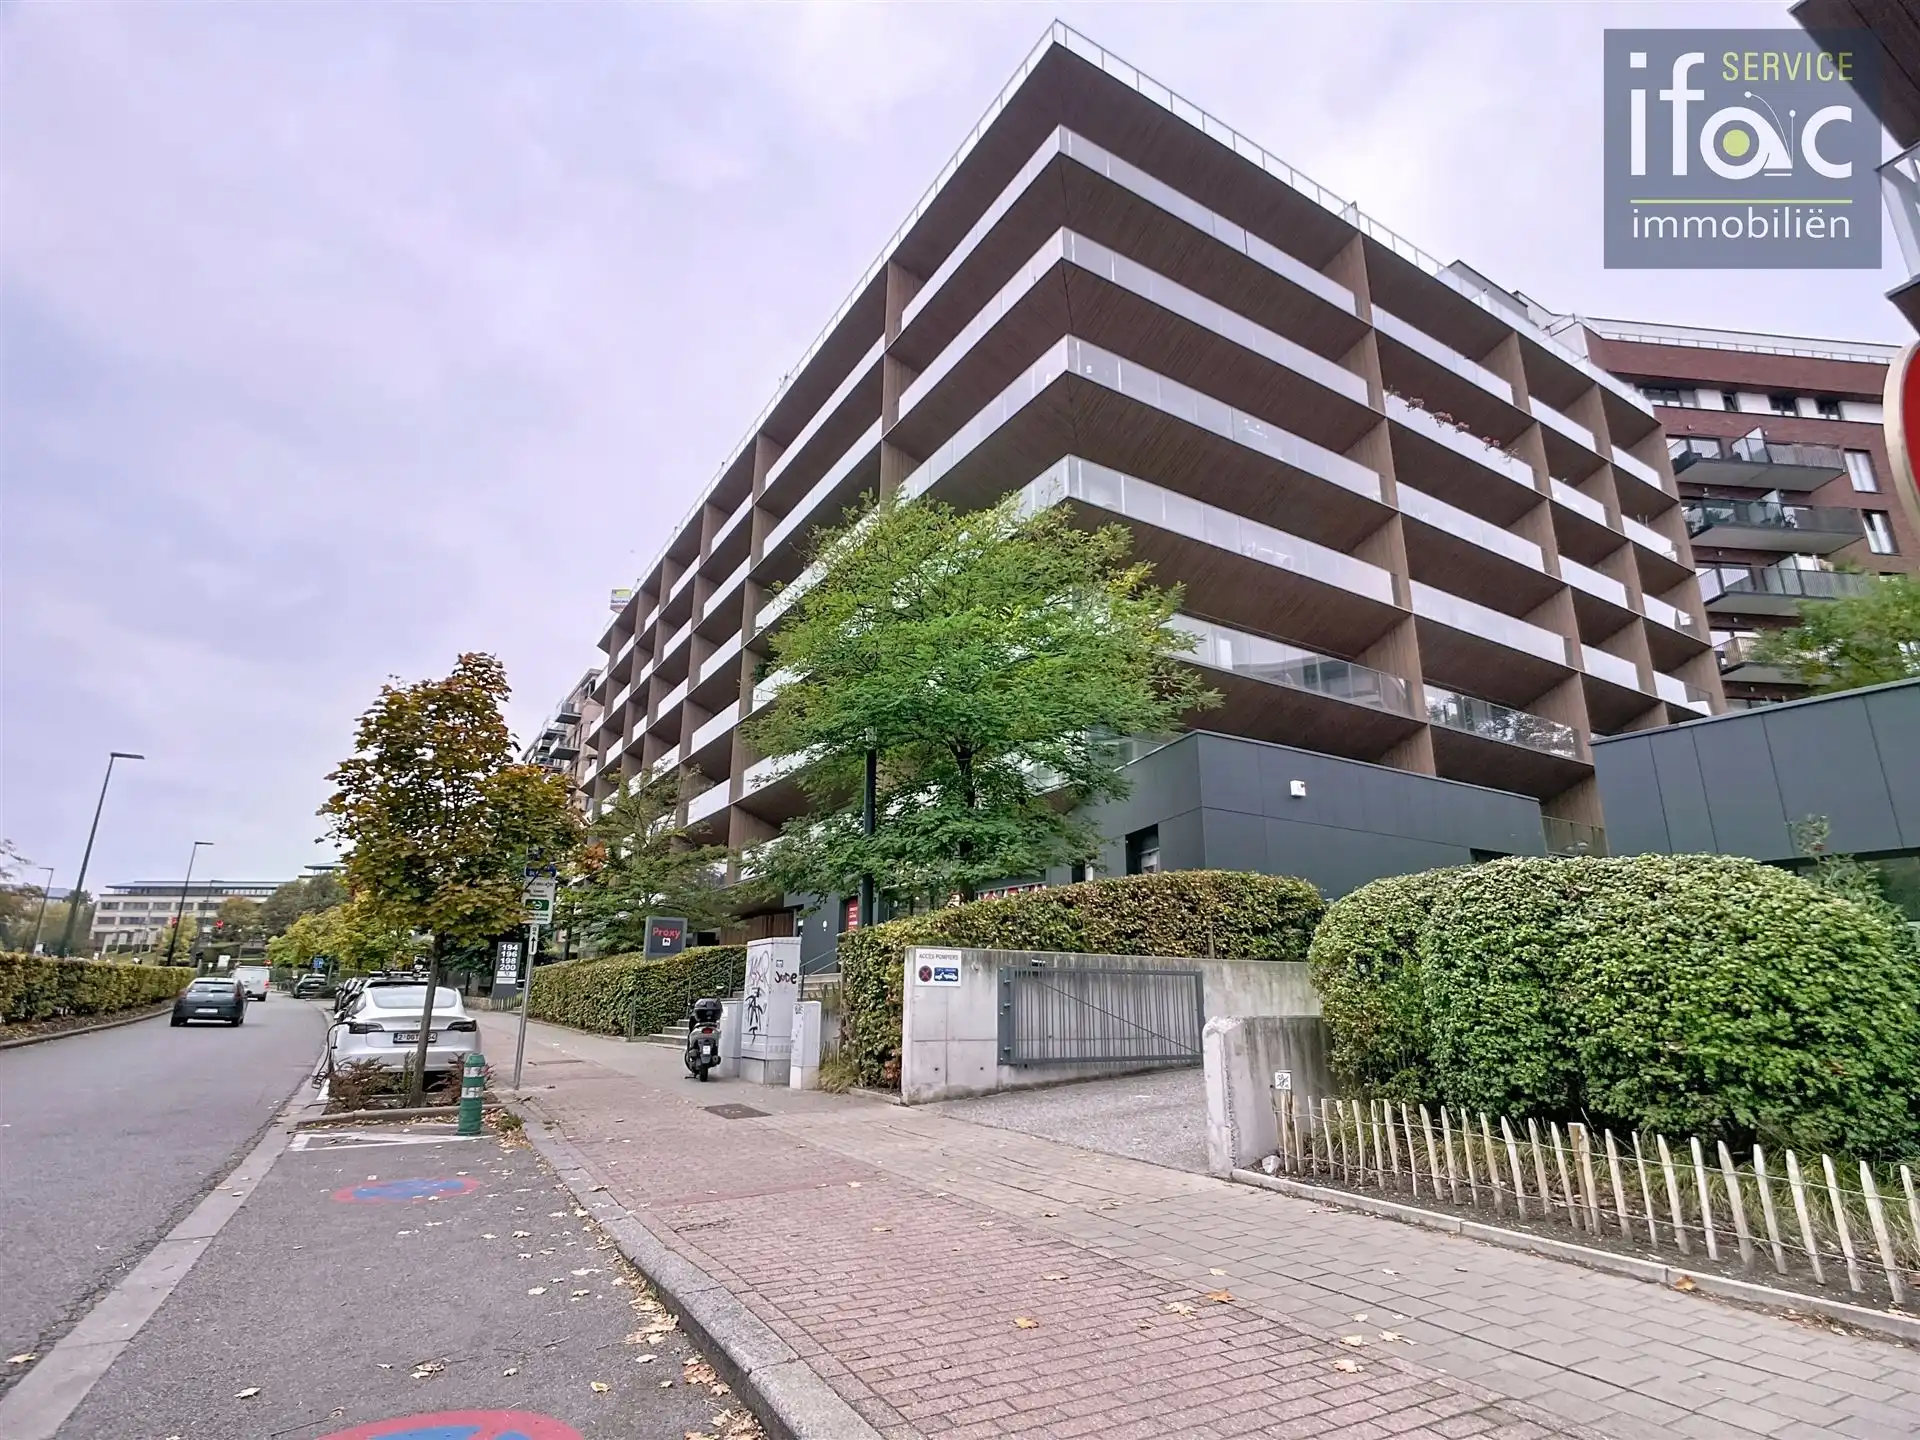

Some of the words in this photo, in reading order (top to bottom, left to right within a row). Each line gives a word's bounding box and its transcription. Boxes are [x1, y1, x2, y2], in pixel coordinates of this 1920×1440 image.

[652, 927, 681, 940] Proxy
[501, 943, 519, 951] 194
[500, 950, 518, 958] 196
[499, 963, 517, 971] 200
